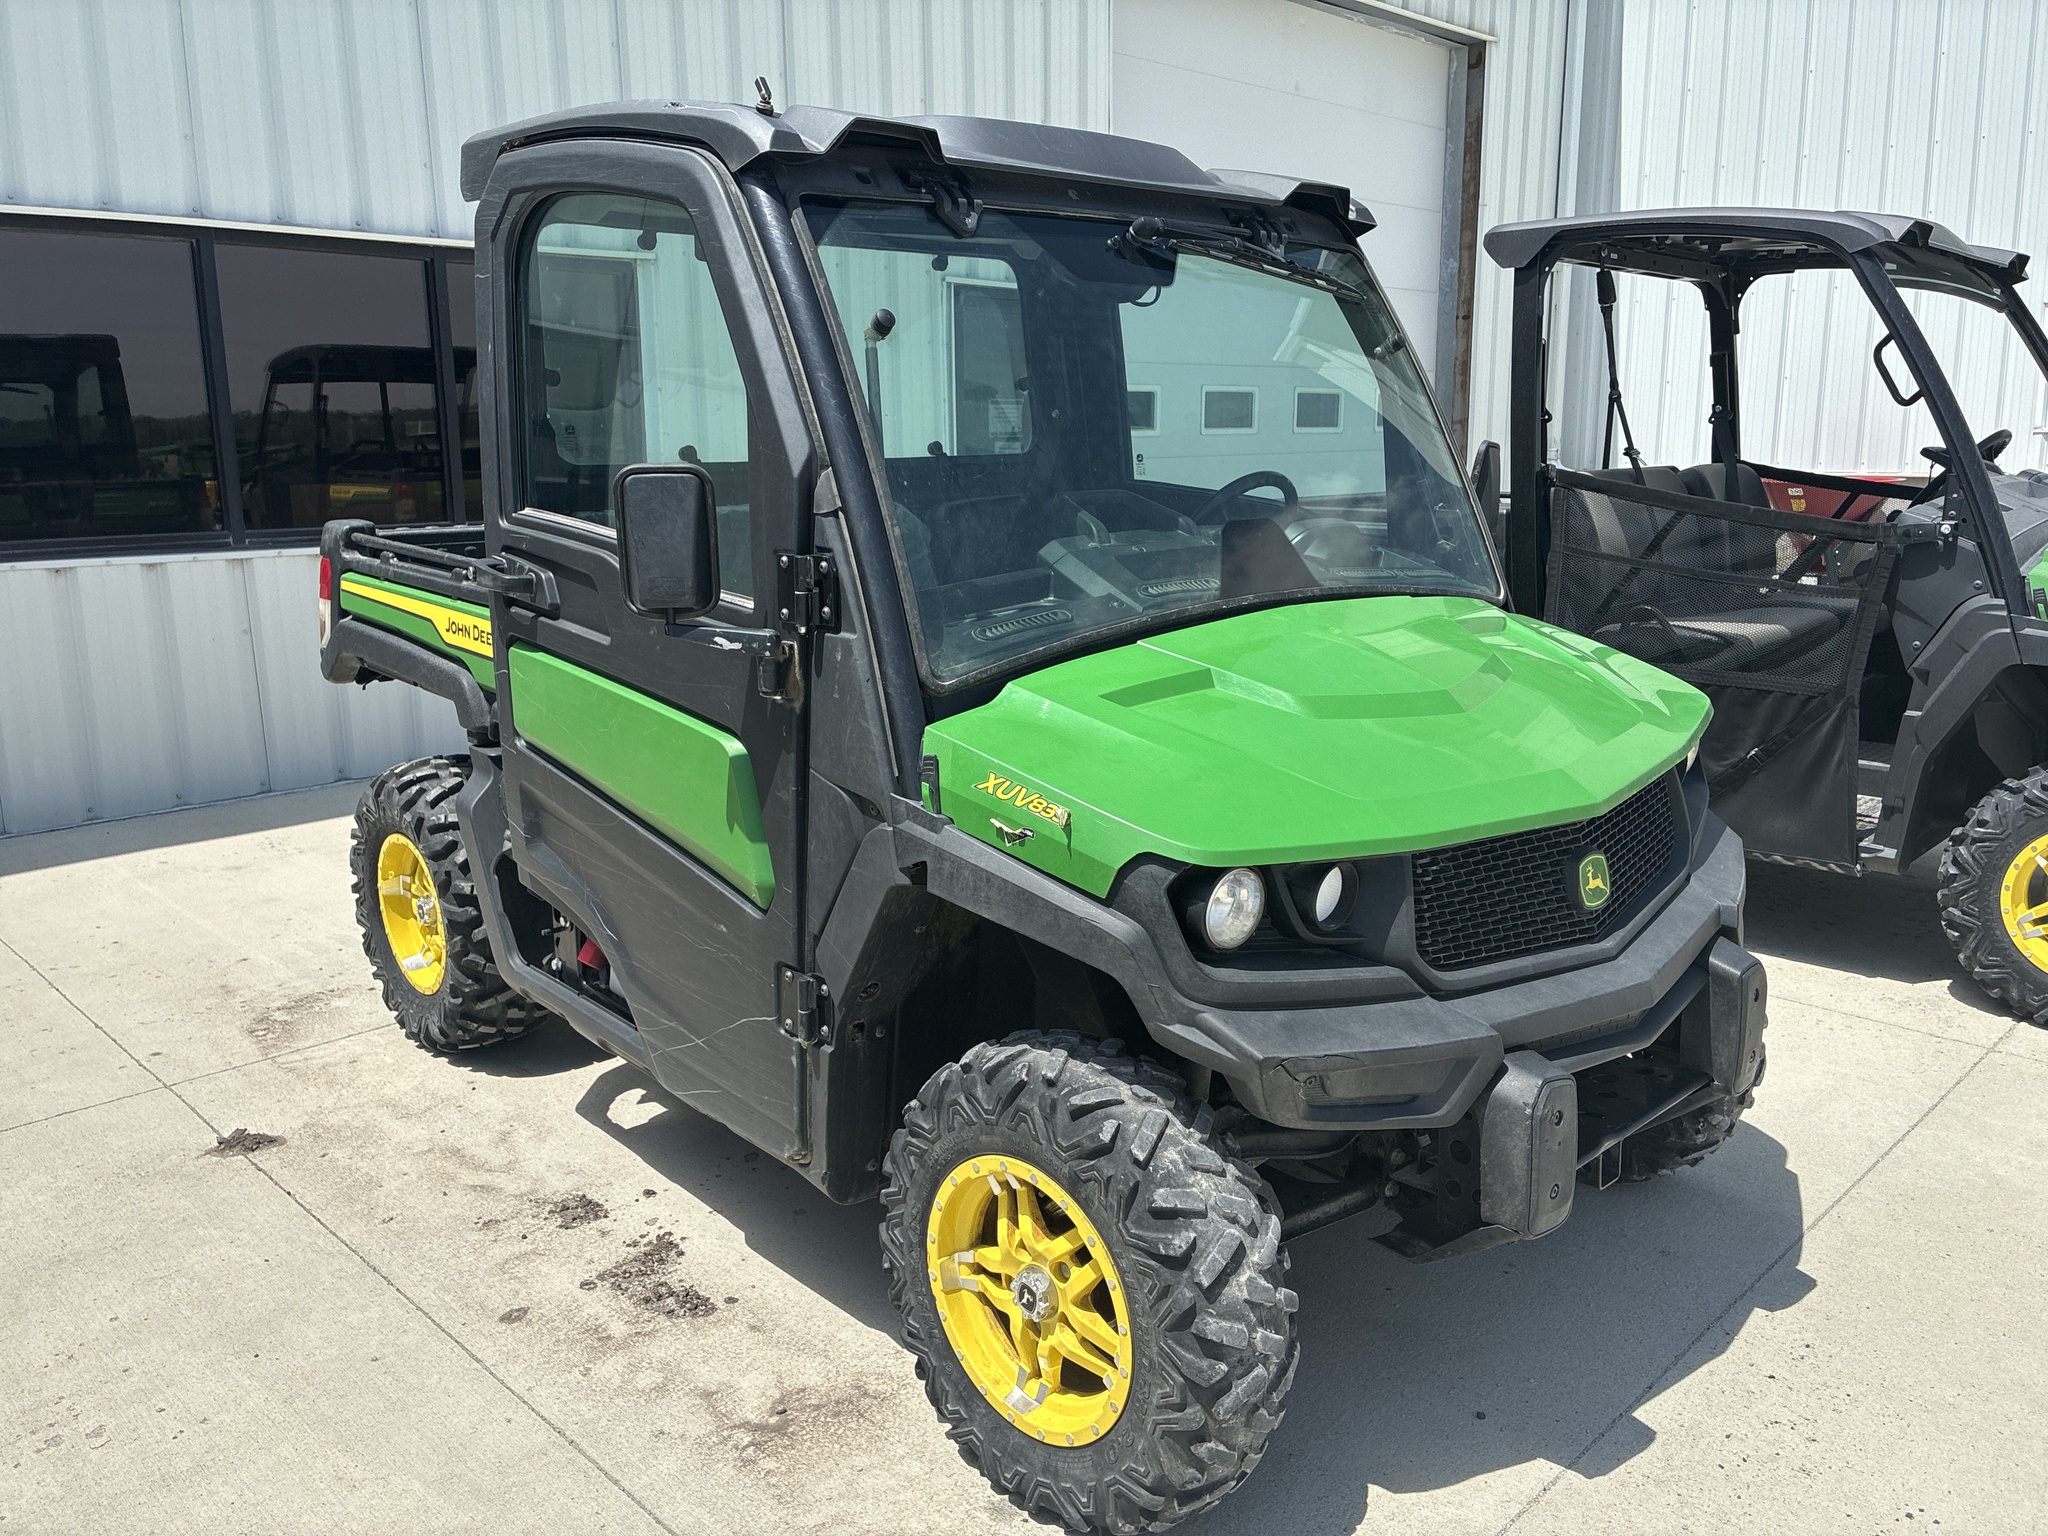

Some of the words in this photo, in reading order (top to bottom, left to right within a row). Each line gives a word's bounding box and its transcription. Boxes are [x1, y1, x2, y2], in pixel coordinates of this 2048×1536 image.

[445, 617, 471, 640] JOHN
[473, 624, 492, 646] DEE
[975, 771, 1063, 825] XUV83
